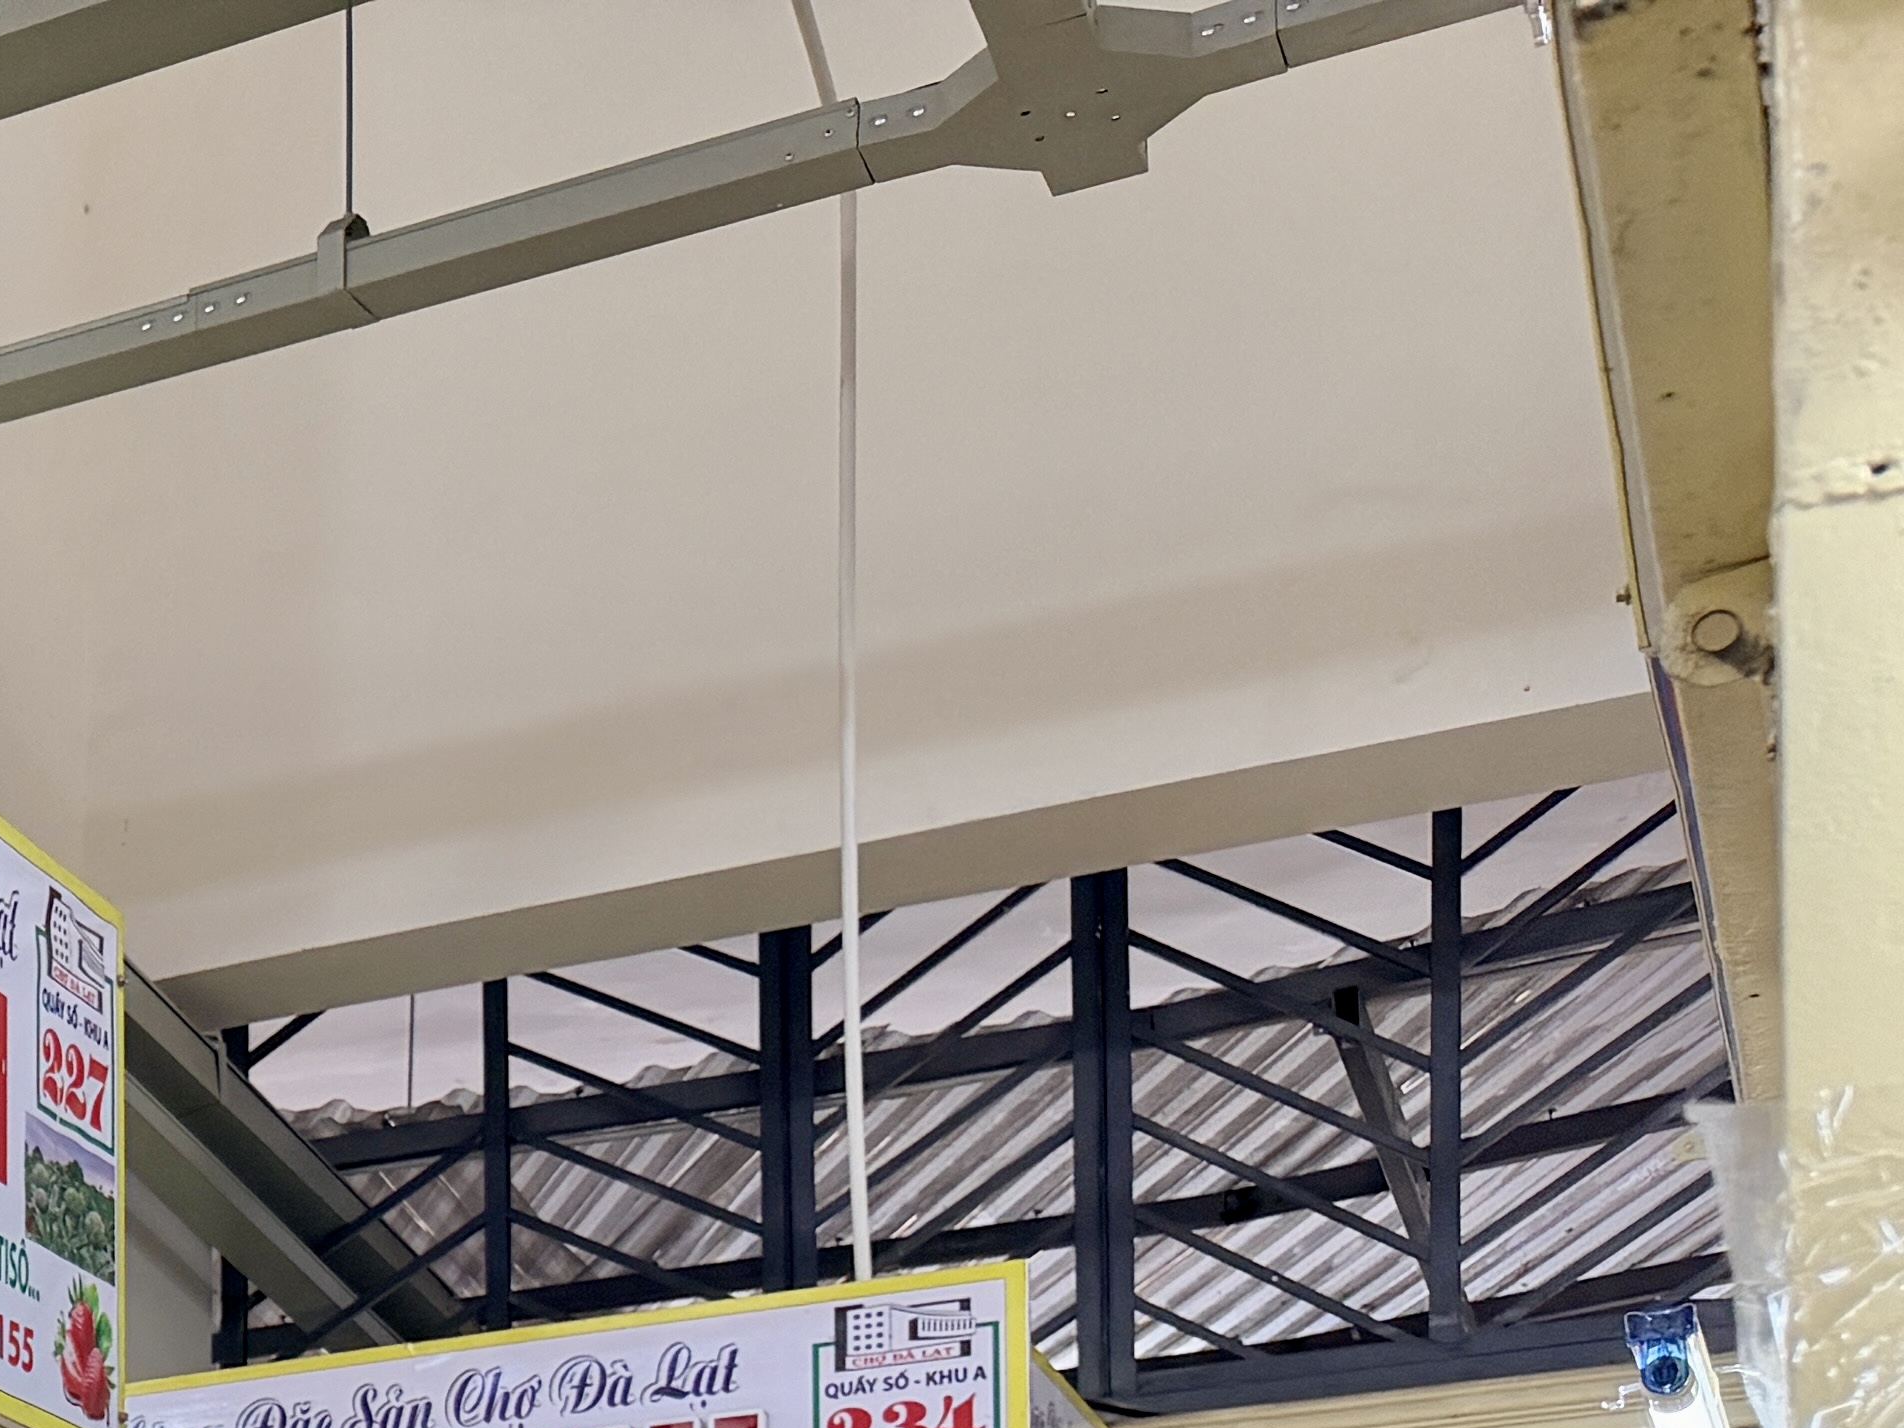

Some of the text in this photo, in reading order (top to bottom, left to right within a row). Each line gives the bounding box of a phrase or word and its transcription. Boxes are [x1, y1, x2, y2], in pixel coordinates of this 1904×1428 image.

[43, 1028, 108, 1132] 227
[549, 1355, 635, 1418] Đà
[641, 1341, 738, 1409] Lạt
[882, 1369, 909, 1392] SỐ
[925, 1367, 968, 1387] KHU
[973, 1365, 987, 1381] A
